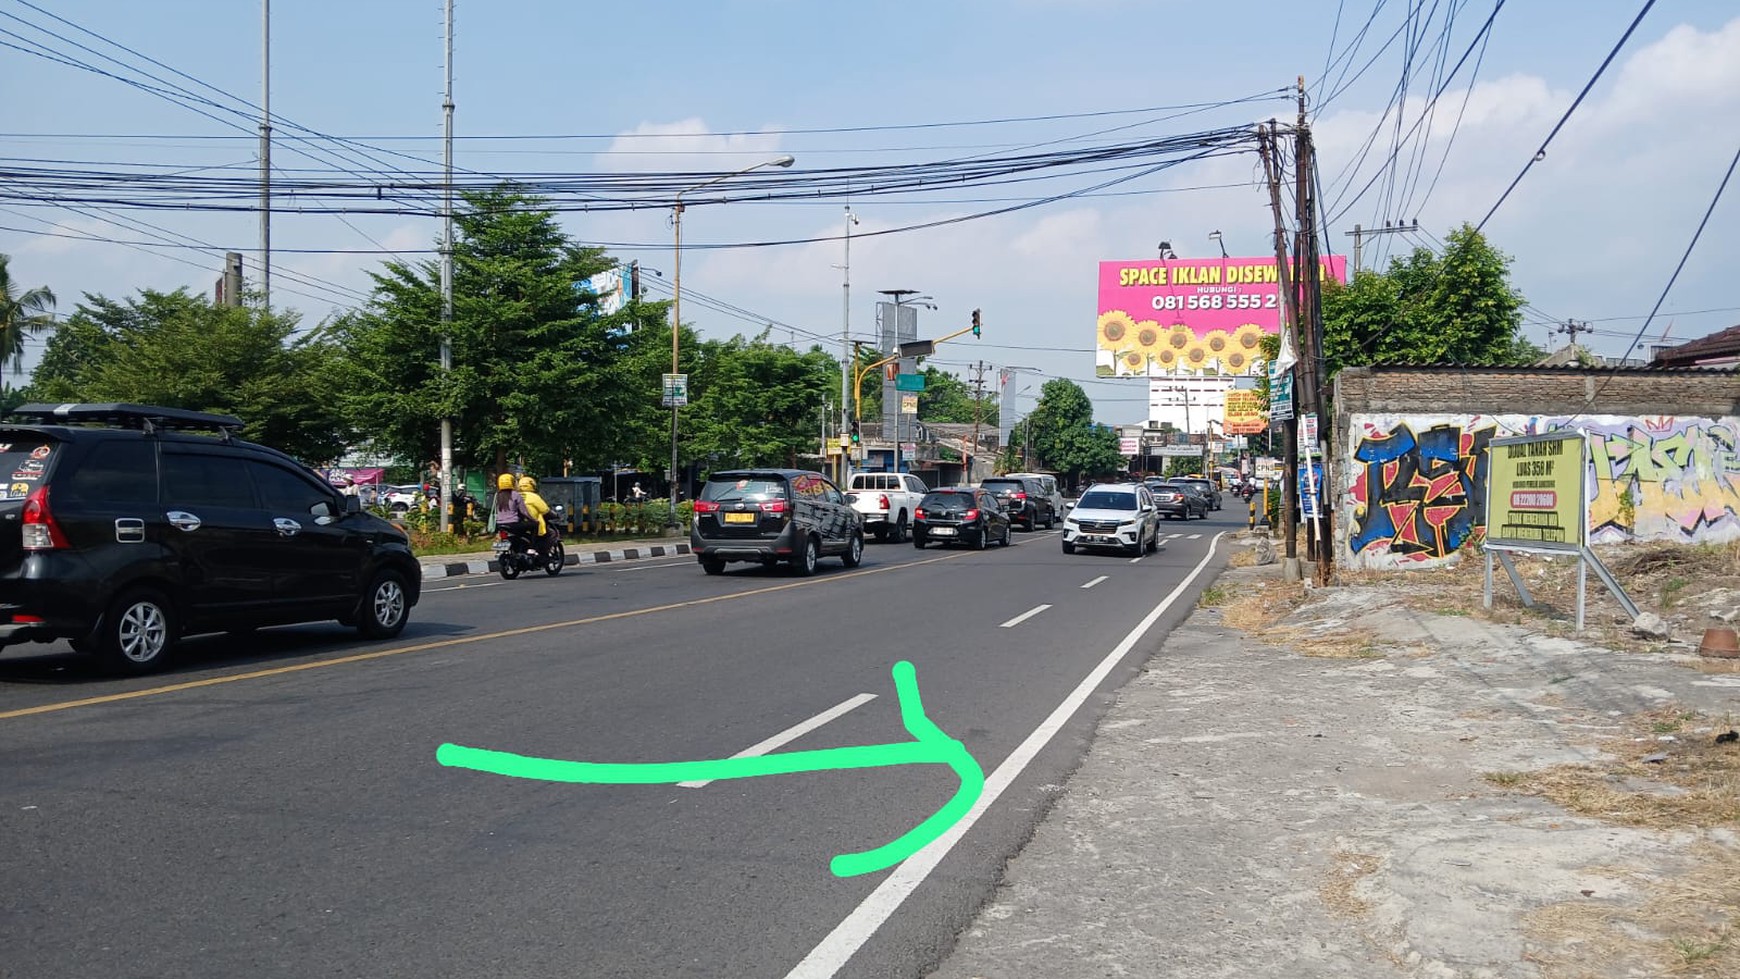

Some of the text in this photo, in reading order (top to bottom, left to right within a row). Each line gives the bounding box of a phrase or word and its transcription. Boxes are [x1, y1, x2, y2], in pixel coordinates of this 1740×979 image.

[1119, 267, 1168, 286] SPACE
[1172, 265, 1221, 285] IKLAN
[1152, 295, 1184, 310] 081
[1187, 294, 1222, 309] 568
[1226, 294, 1262, 309] 555
[1516, 462, 1531, 477] LUAS
